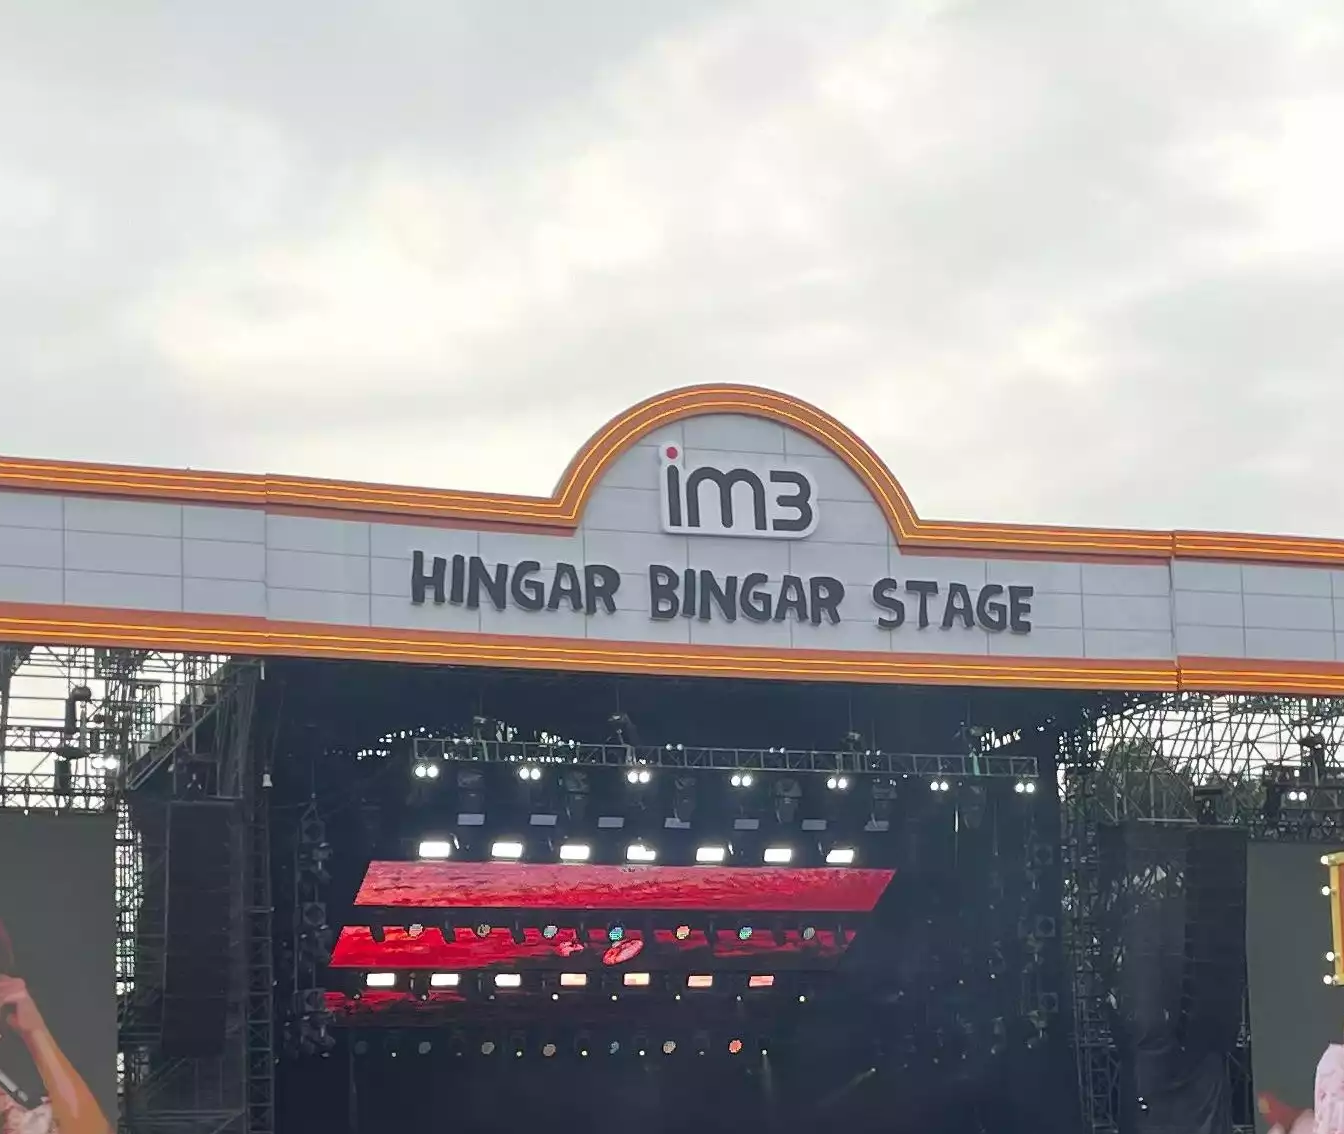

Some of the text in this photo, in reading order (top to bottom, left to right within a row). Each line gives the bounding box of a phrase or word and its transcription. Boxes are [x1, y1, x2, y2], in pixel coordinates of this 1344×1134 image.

[409, 549, 1035, 634] HINGAR BINGAR STAGE
